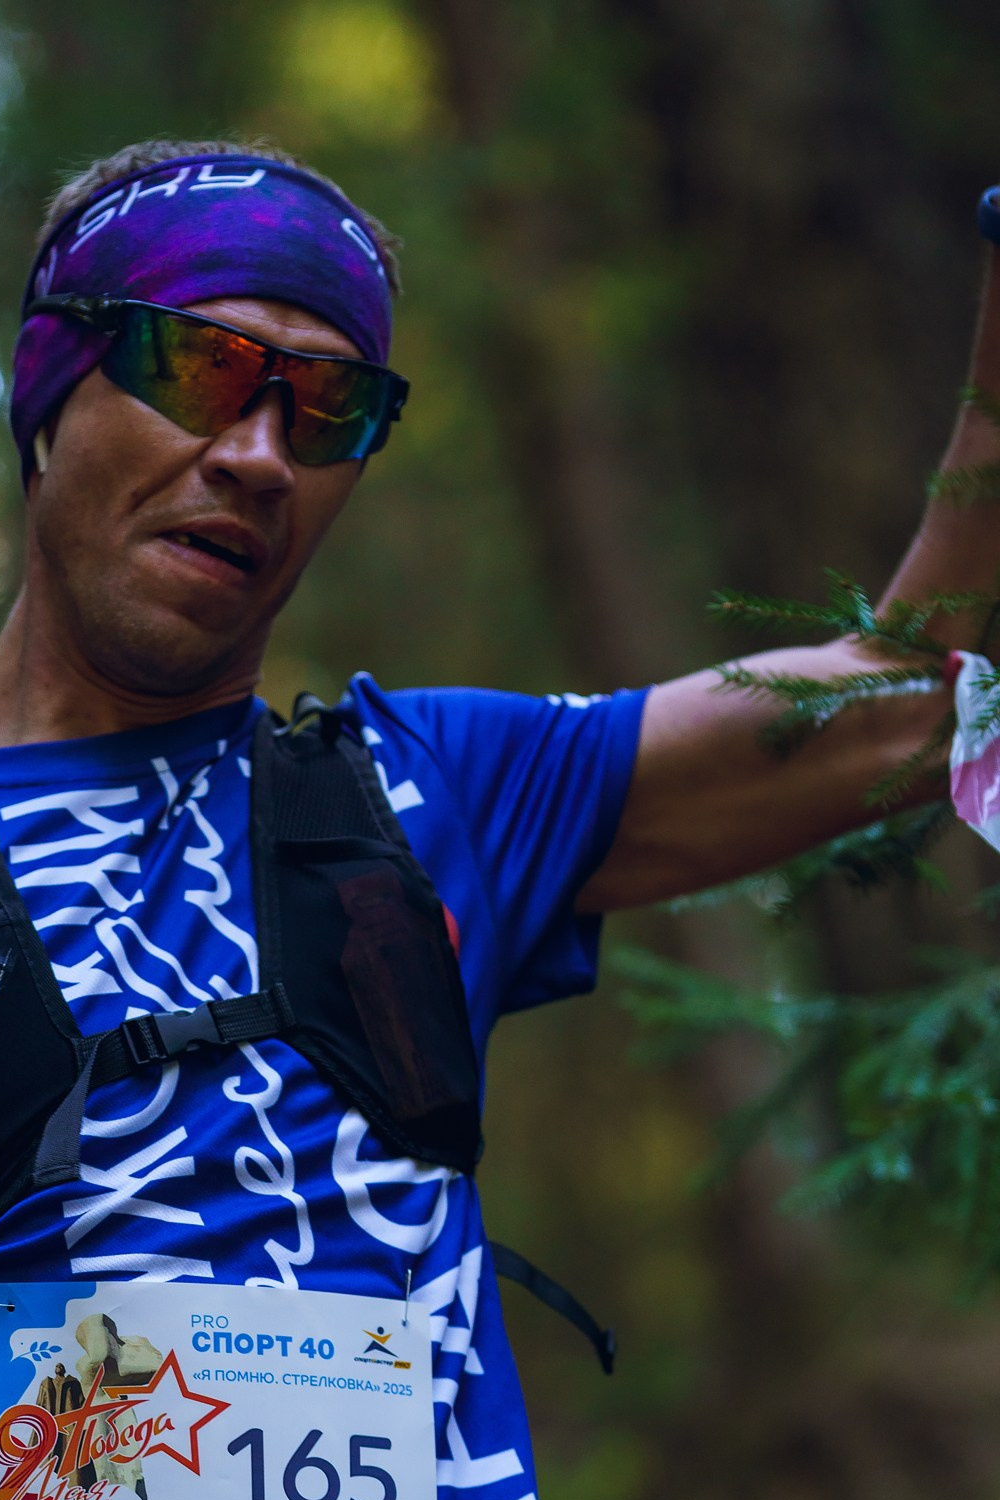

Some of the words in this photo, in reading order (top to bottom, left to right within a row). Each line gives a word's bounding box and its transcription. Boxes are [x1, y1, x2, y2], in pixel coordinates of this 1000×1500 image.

[190, 1313, 230, 1329] PRO
[191, 1330, 293, 1357] СПОРТ
[299, 1337, 335, 1360] 40
[192, 1369, 212, 1381] «Я
[215, 1370, 279, 1384] ПОМНЮ.
[282, 1373, 381, 1392] СТРЕЛКОВКА»
[383, 1382, 413, 1397] 2025
[54, 1363, 175, 1478] Победа
